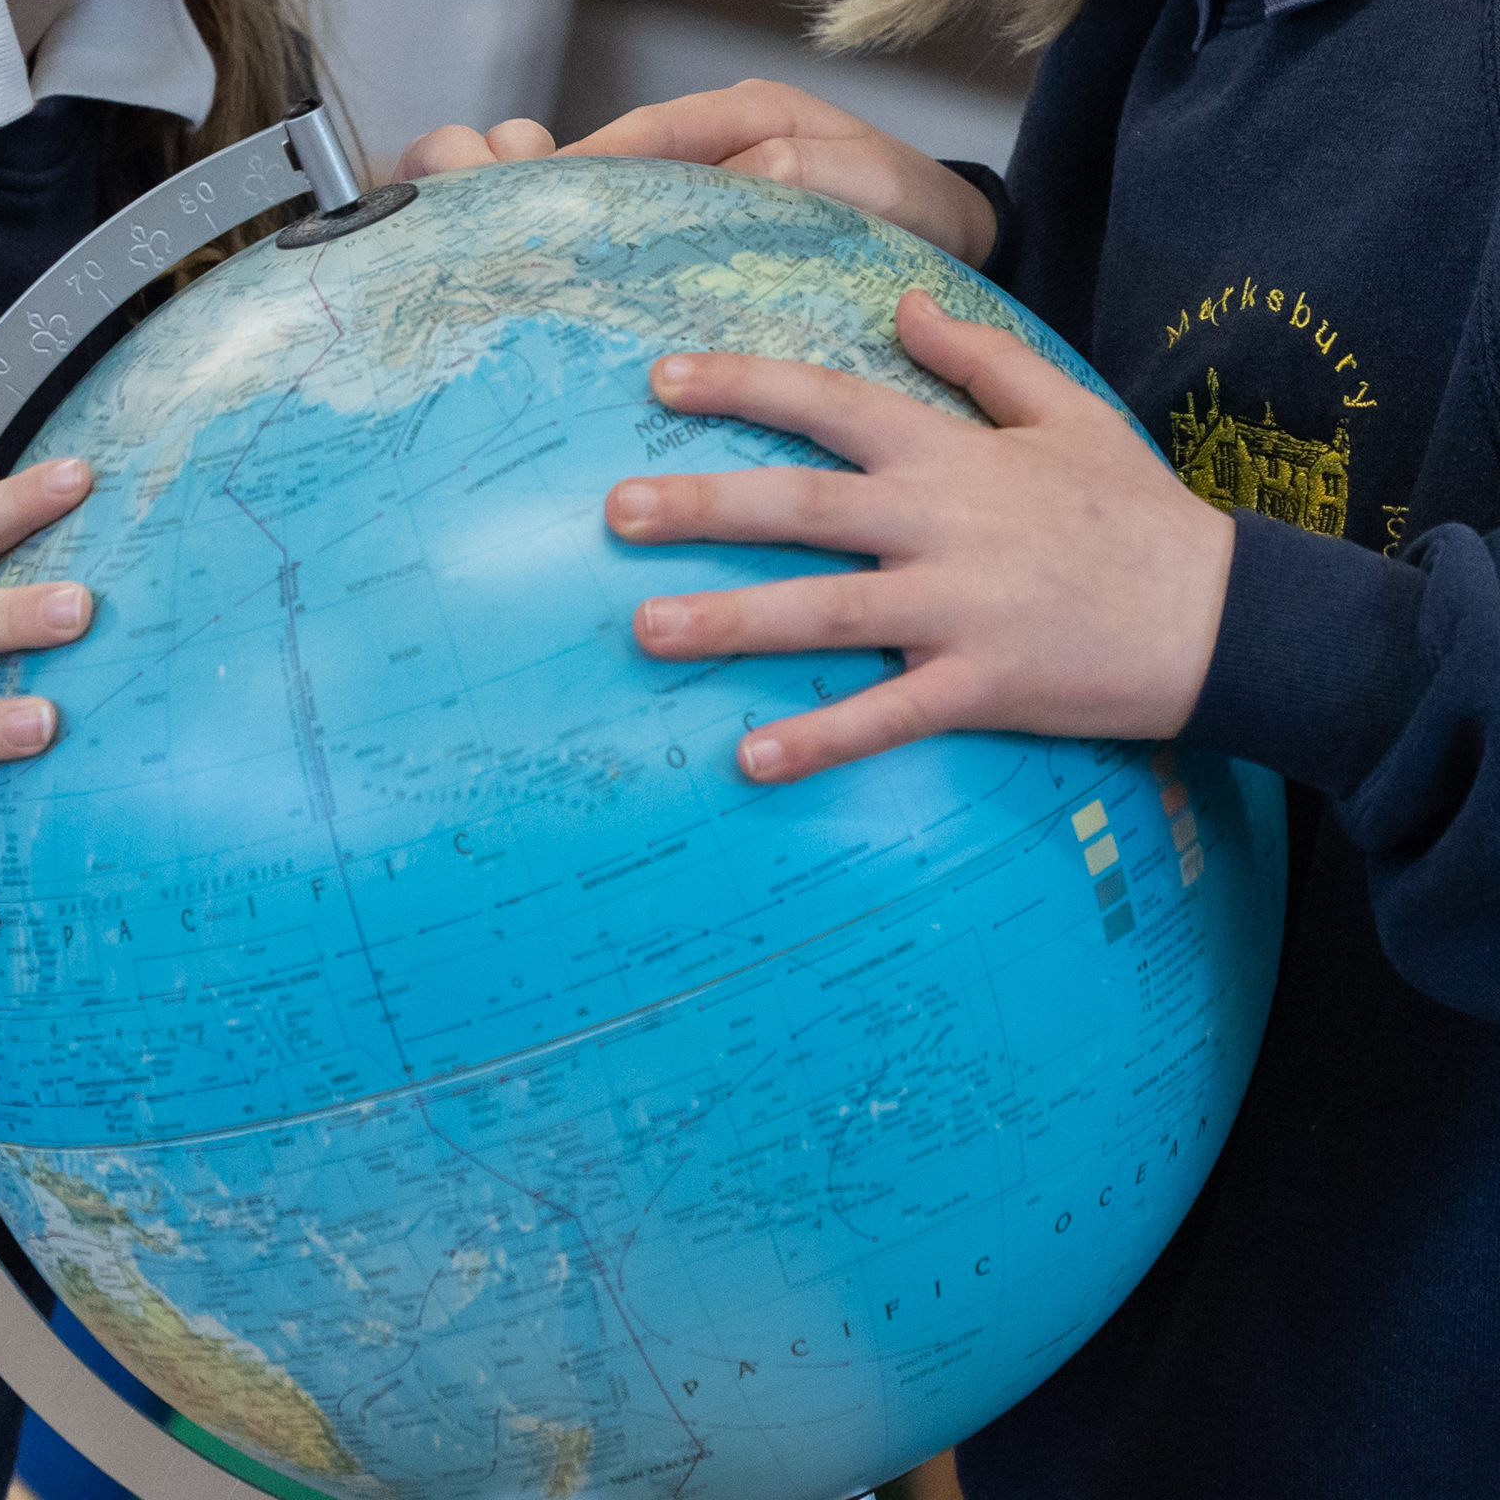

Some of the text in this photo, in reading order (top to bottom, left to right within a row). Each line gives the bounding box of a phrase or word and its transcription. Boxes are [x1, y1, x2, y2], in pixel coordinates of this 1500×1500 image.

[178, 181, 216, 214] 80
[66, 259, 105, 295] 70
[1166, 276, 1378, 408] Marksbury
[634, 405, 682, 439] NOR
[645, 414, 726, 462] AMERIC
[682, 1257, 991, 1398] PACIFIC
[1054, 1112, 1209, 1235] OCEAN
